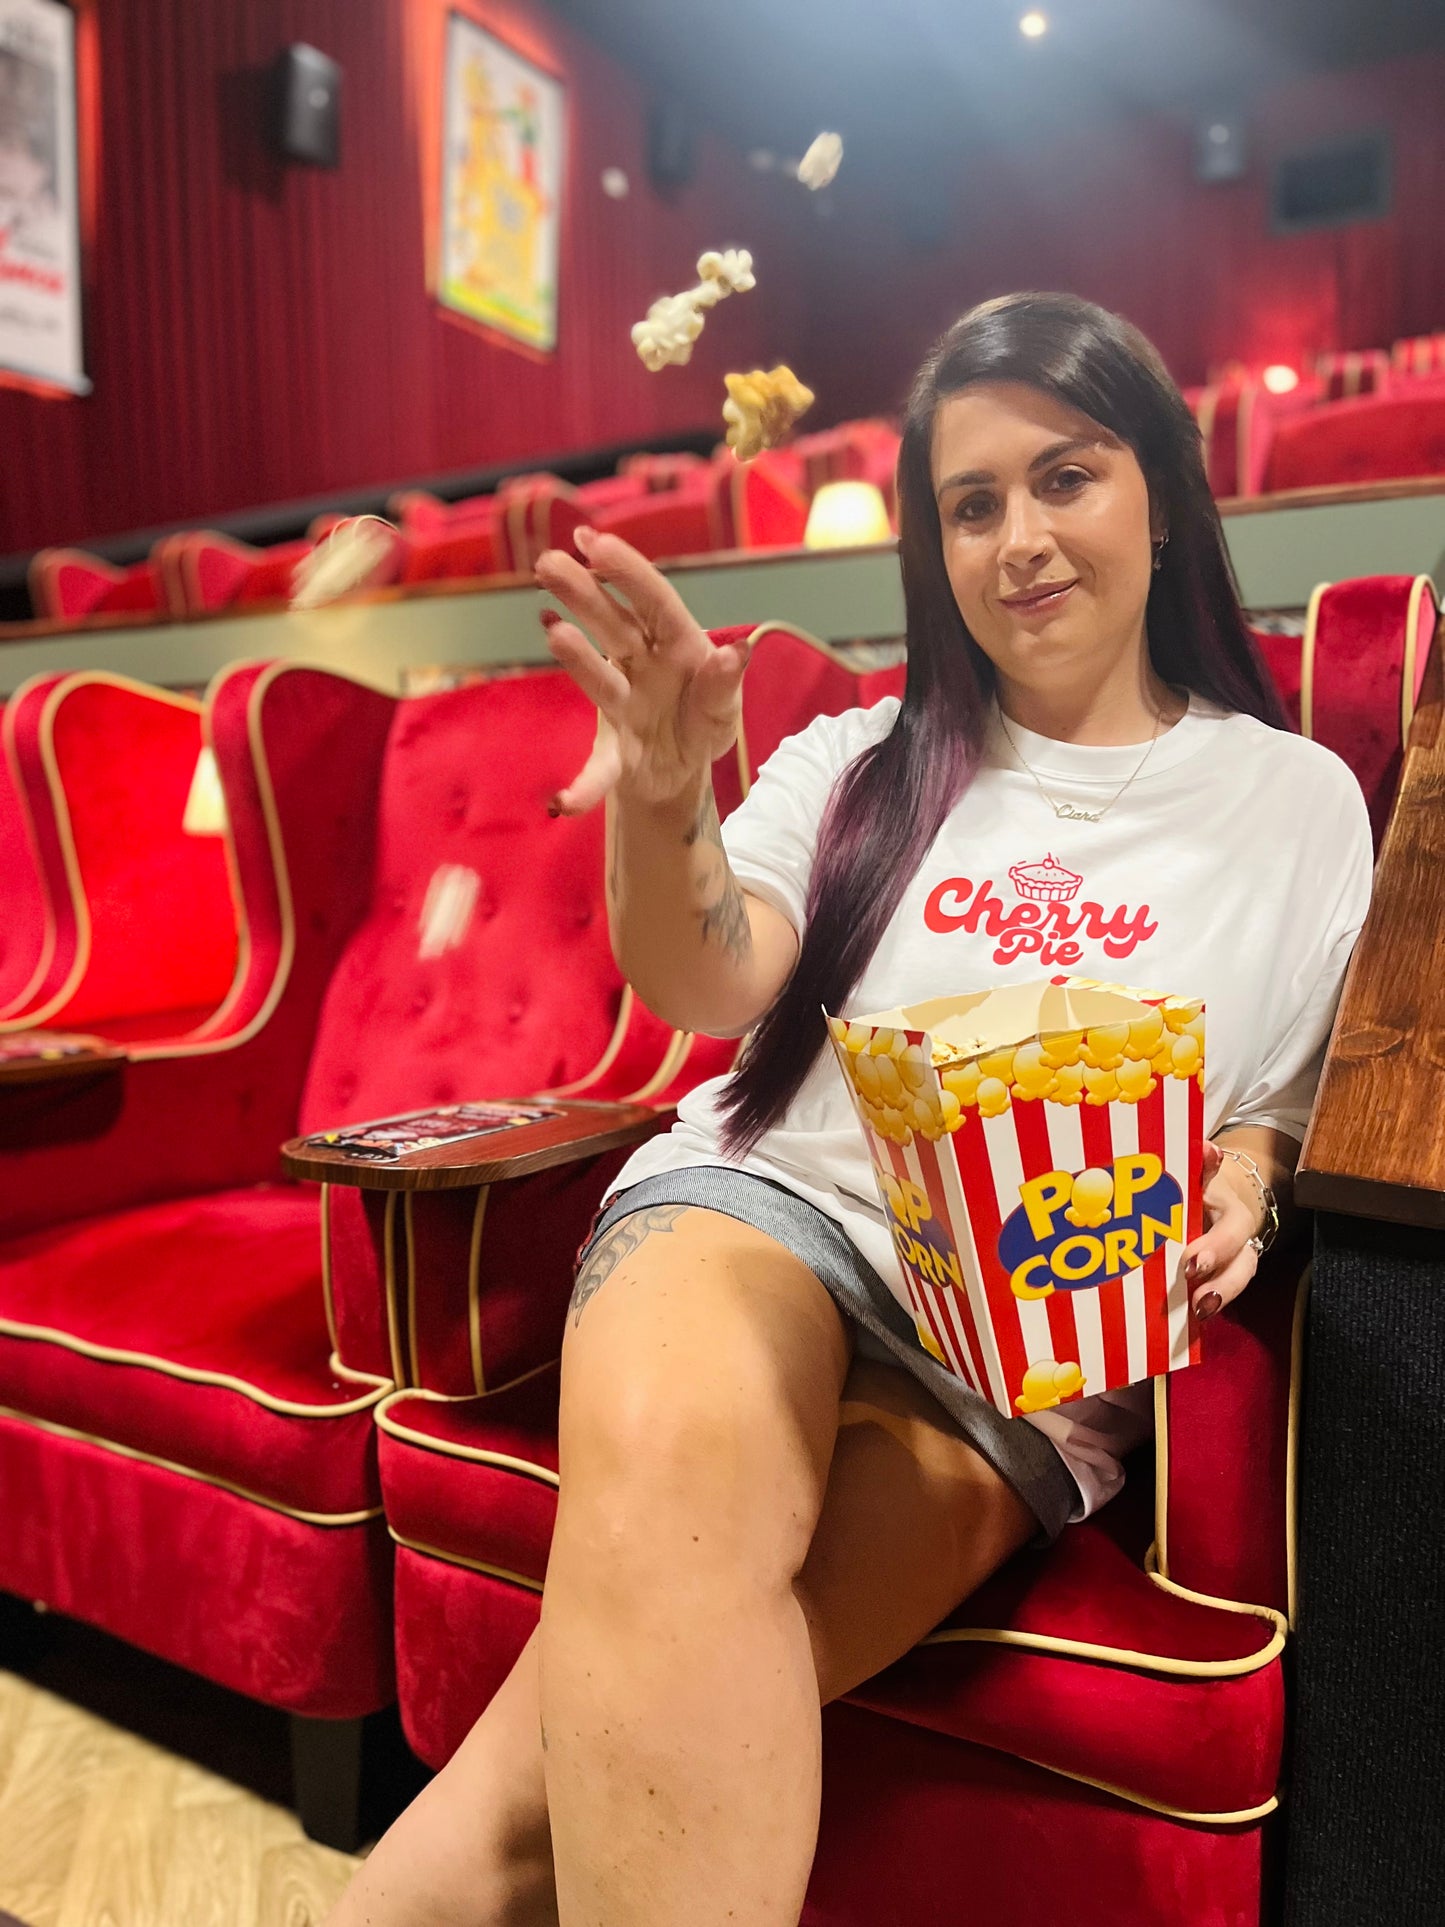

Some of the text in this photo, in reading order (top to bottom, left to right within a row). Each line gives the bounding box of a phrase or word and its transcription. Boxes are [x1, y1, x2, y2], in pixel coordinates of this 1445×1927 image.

[923, 877, 1159, 959] Cherry
[992, 927, 1085, 966] Pie
[1018, 1152, 1163, 1242] POP
[890, 1220, 965, 1294] ORN
[1010, 1203, 1184, 1301] CORN
